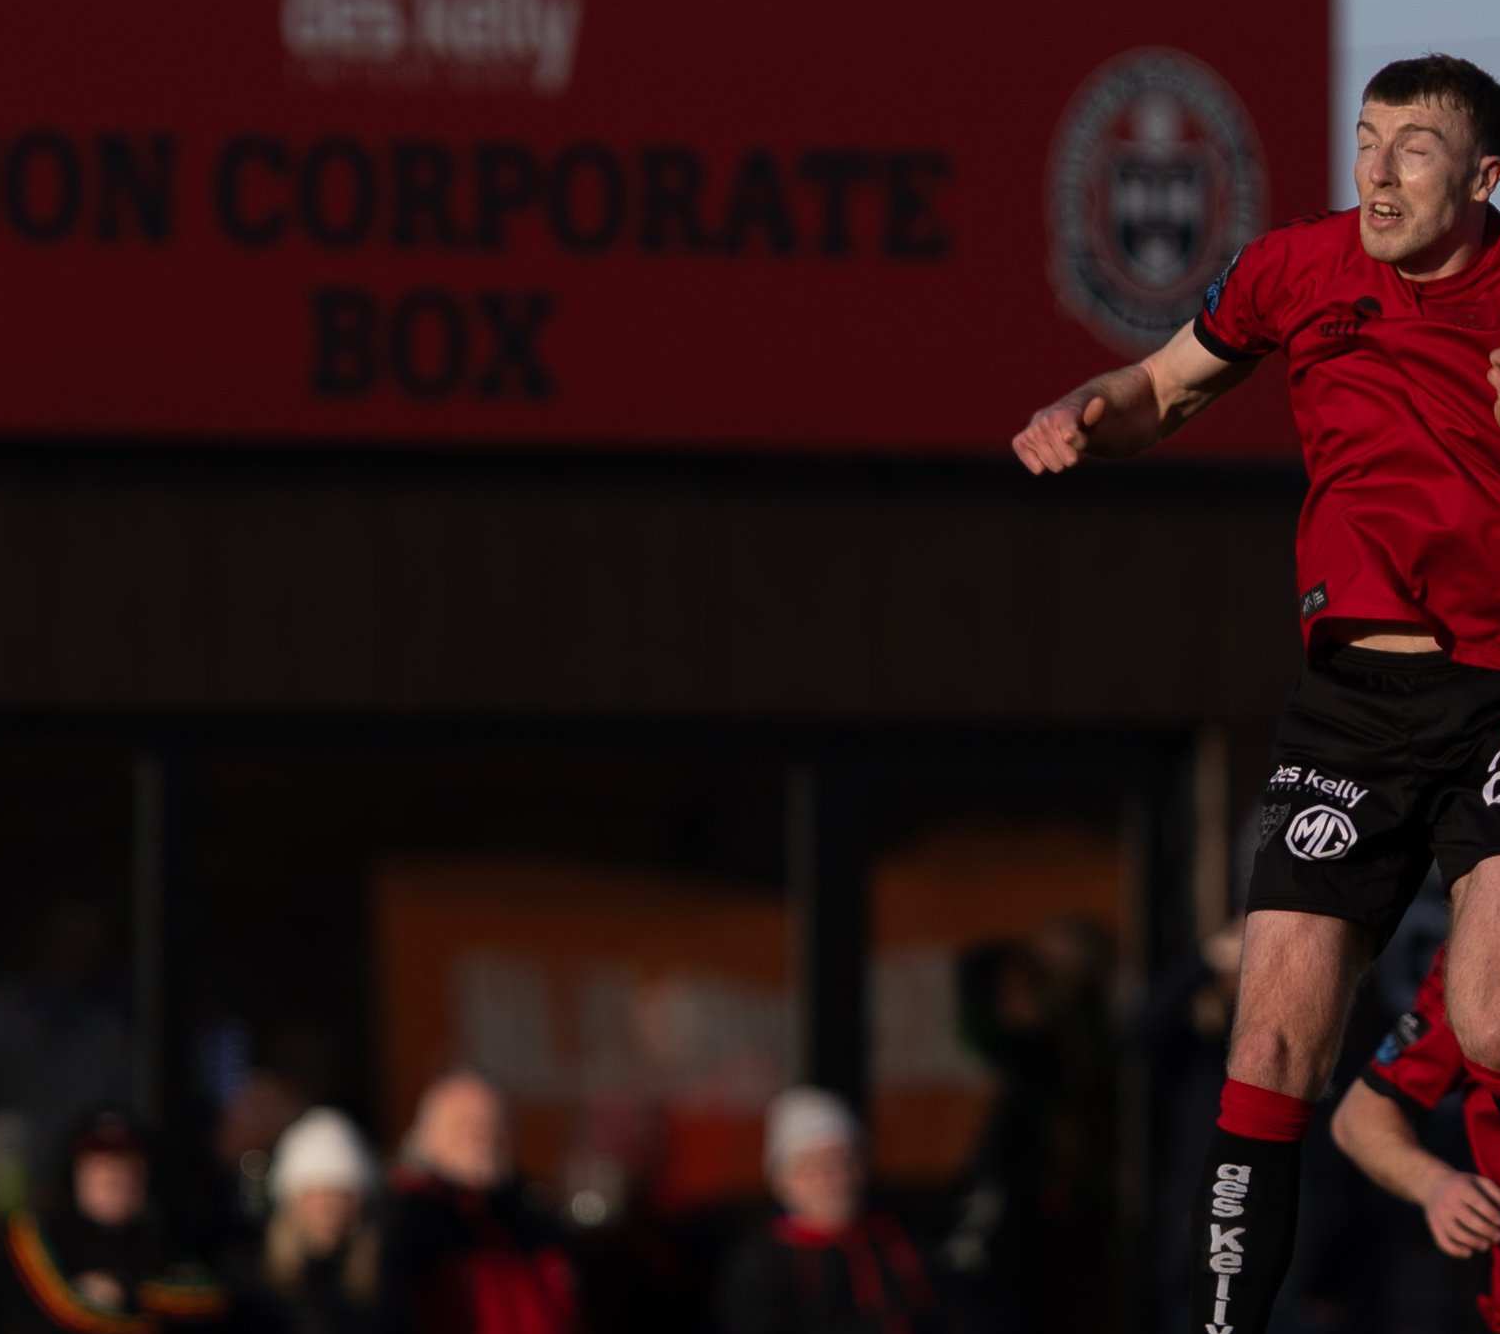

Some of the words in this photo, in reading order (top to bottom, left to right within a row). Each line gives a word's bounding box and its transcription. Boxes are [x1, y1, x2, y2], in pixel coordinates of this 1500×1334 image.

[214, 133, 953, 259] CORPORATE
[311, 286, 553, 401] BOX
[1304, 769, 1369, 808] kelly
[1292, 810, 1351, 859] MG
